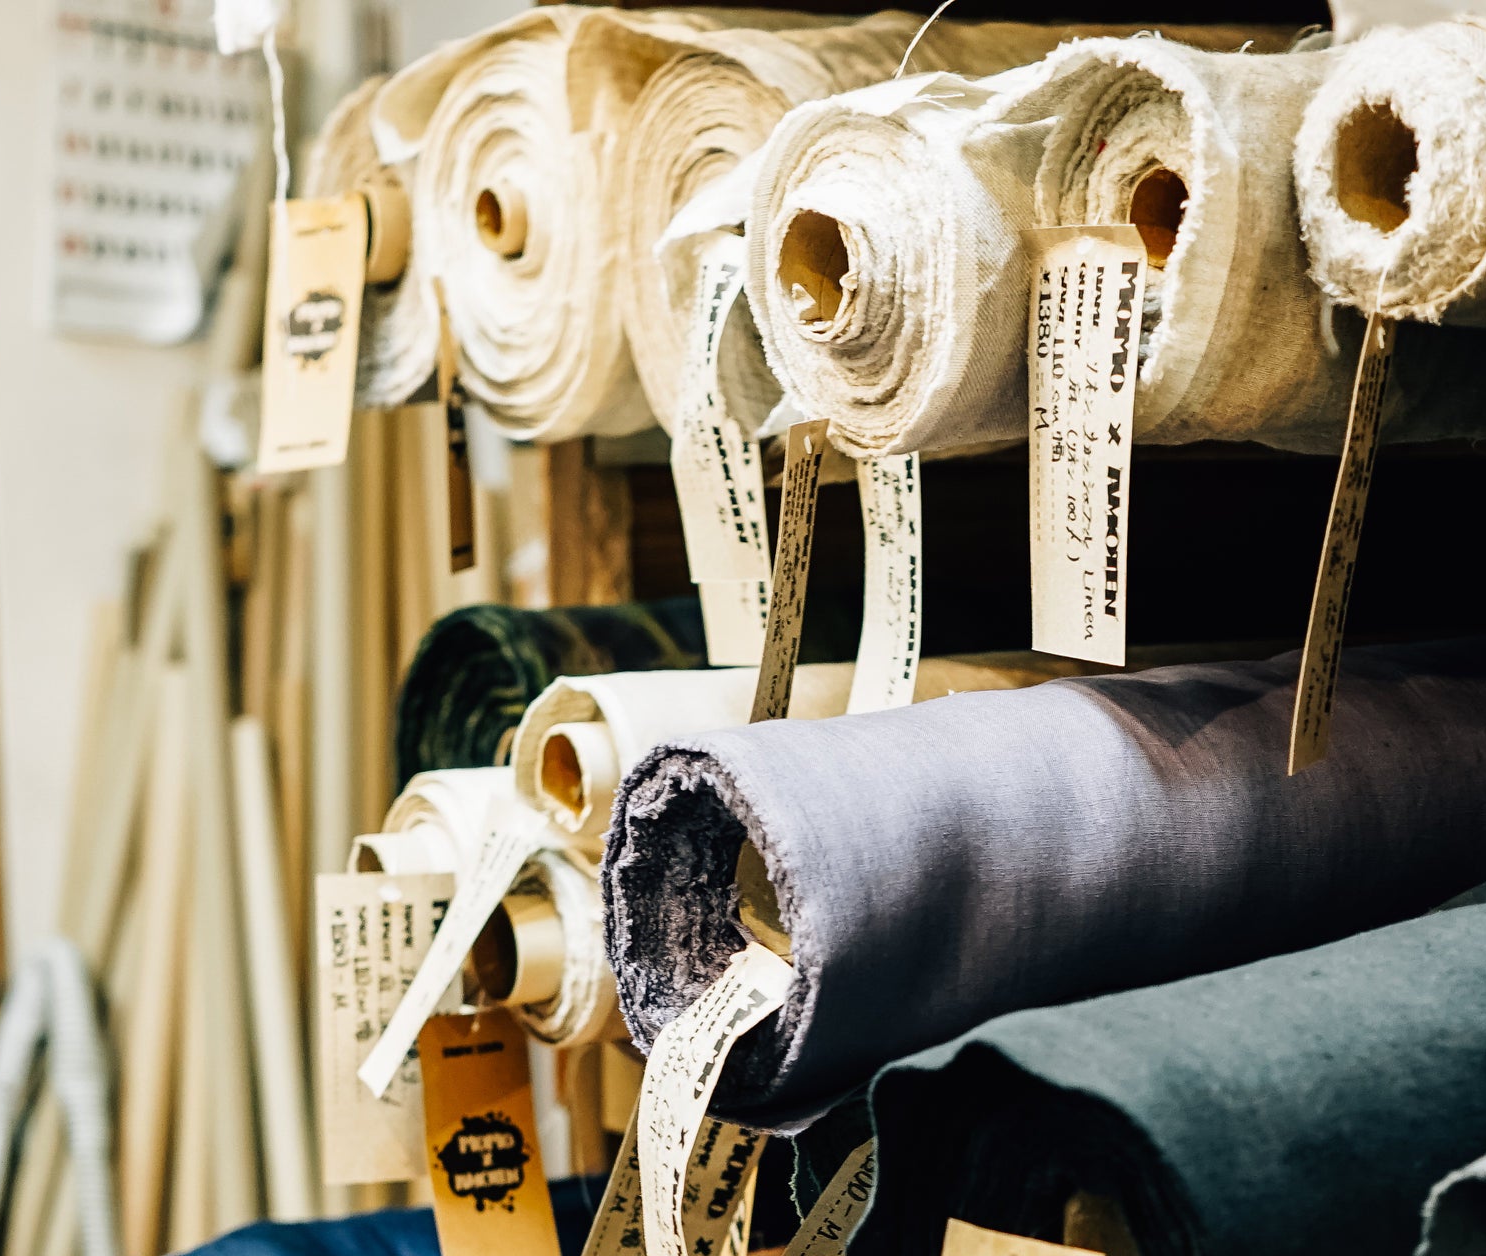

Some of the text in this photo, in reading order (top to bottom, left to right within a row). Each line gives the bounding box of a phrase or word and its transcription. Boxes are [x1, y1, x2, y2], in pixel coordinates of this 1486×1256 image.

[1075, 263, 1086, 348] QUALITY
[1093, 267, 1104, 326] NAME
[1110, 262, 1138, 392] MOMO
[1053, 338, 1064, 379] 110
[1084, 571, 1093, 640] Linen
